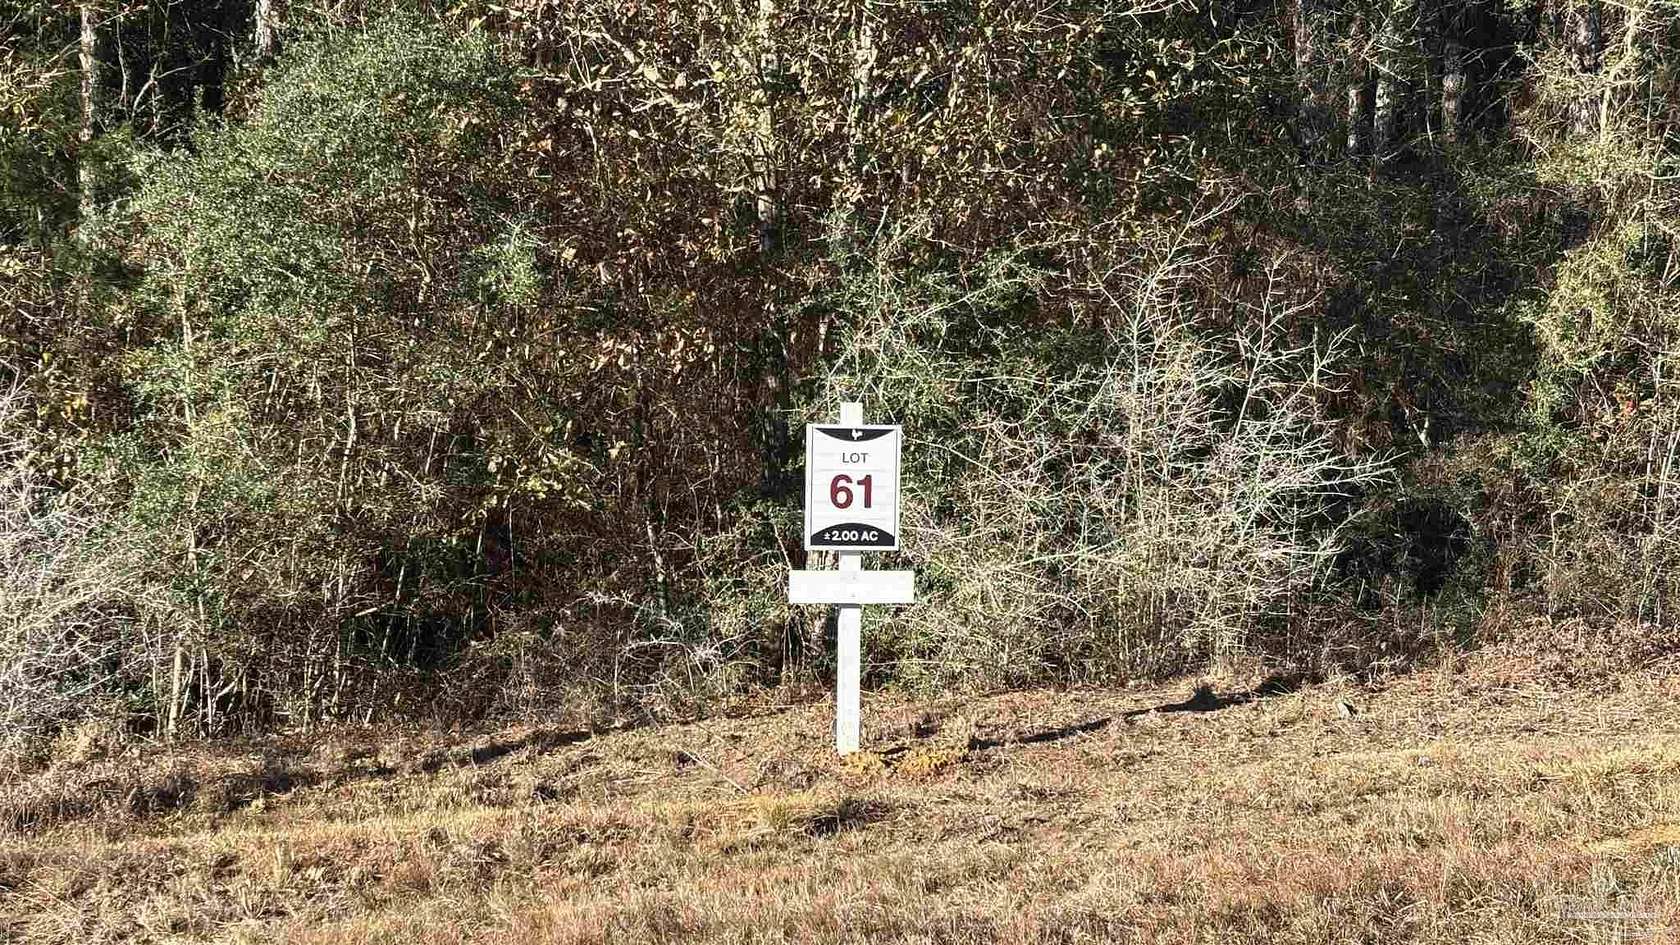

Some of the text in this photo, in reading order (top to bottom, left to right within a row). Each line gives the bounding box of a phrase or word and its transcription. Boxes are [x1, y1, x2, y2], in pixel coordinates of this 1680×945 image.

[842, 452, 869, 464] LOT
[830, 473, 873, 510] 61
[823, 529, 879, 542] ±2.00 AC
